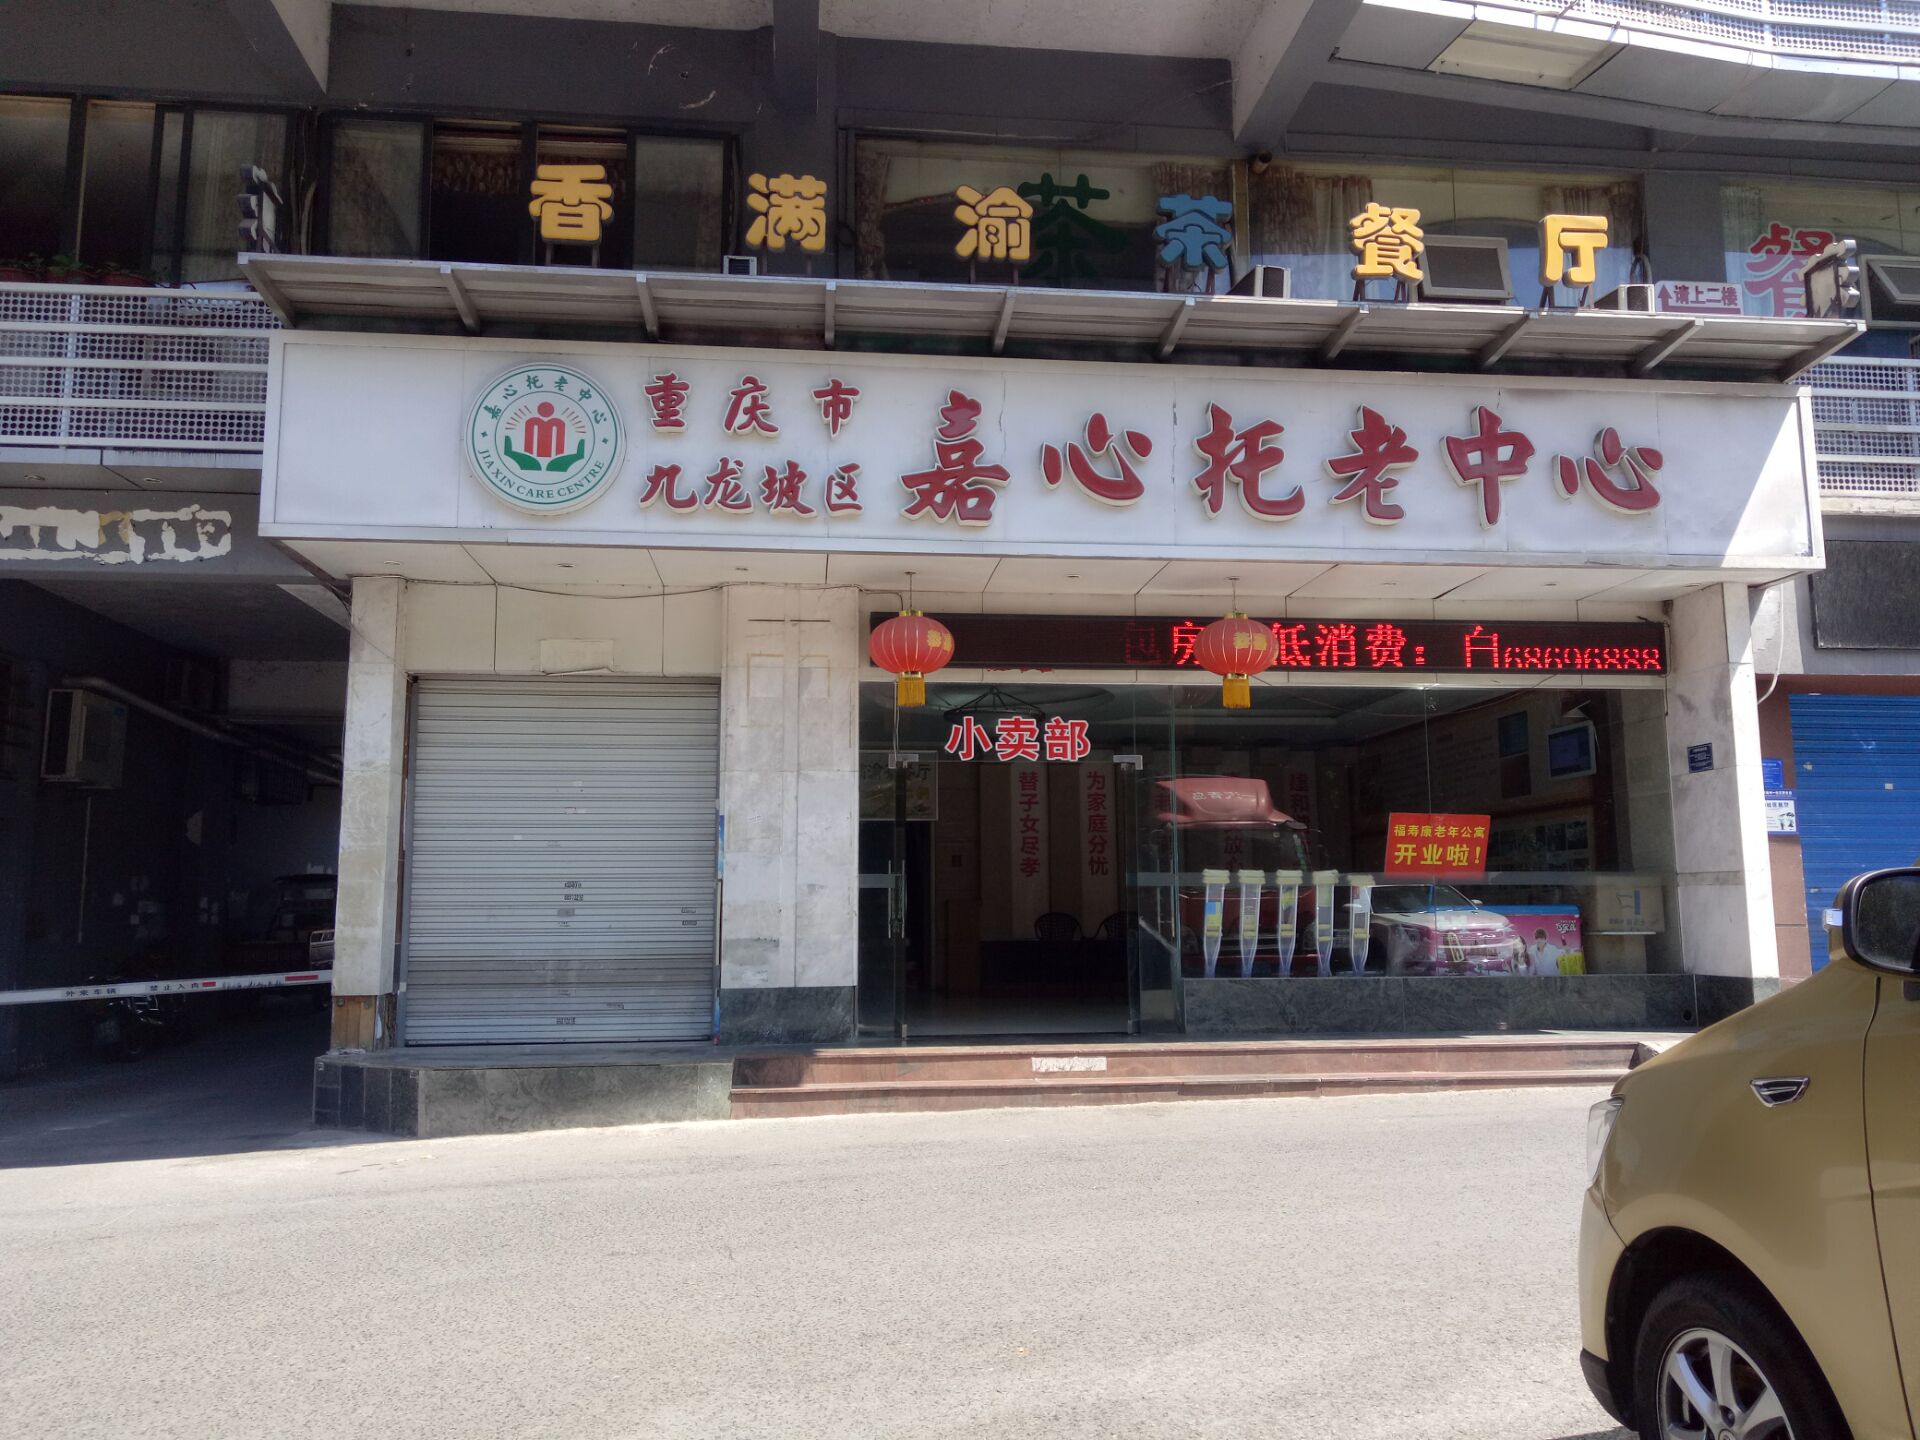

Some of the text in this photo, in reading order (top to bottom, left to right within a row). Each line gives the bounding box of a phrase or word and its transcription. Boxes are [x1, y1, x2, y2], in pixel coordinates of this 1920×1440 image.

[1673, 284, 1738, 306] 请上二楼
[483, 374, 608, 424] 嘉心托老中心
[644, 371, 861, 438] 重庆市
[478, 449, 605, 498] JIA XIN CARE CENTRE
[899, 388, 1664, 529] 嘉心托老中心
[640, 456, 864, 518] 九龙坡区
[945, 716, 1092, 762] 小卖部
[1018, 770, 1041, 878] 替子女尽孝
[1087, 769, 1109, 877] 为家庭分忧
[1394, 823, 1486, 839] 福寿康老年公寓
